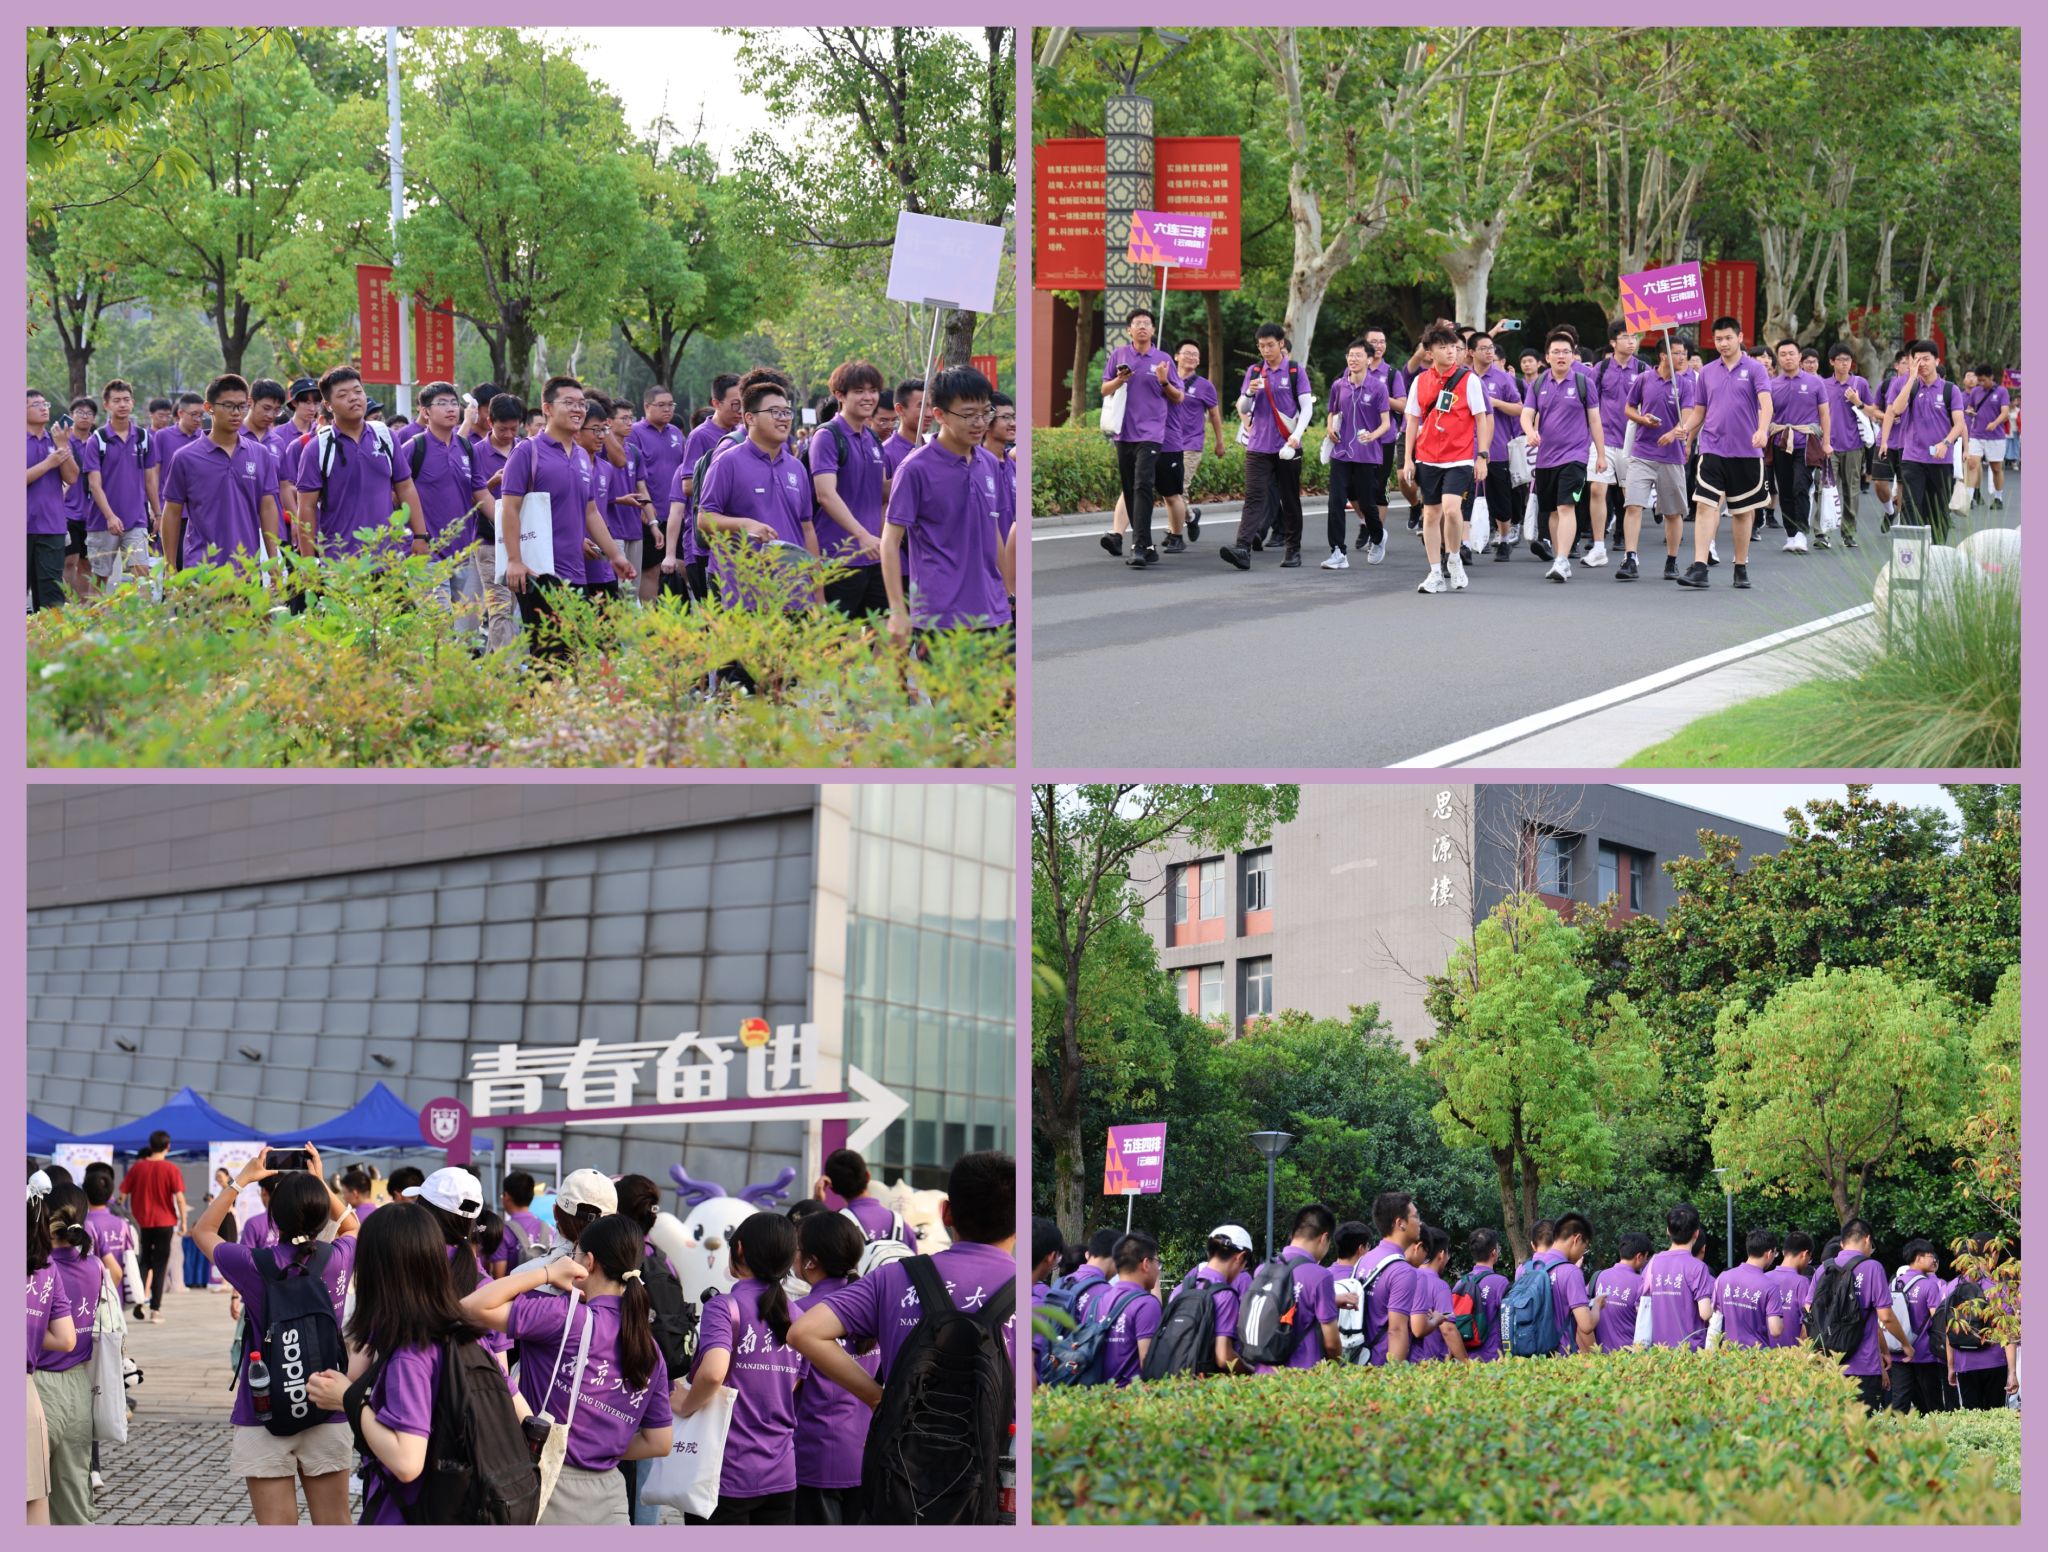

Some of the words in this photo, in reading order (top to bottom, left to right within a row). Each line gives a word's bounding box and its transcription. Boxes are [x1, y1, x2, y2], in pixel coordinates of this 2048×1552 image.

[1153, 222, 1207, 238] 六连三排
[1643, 273, 1697, 296] 六连三排
[467, 1021, 818, 1116] 青春奋进
[282, 1328, 309, 1419] adidas
[736, 1362, 770, 1371] NANJING
[594, 1401, 637, 1425] UNIVERSITY
